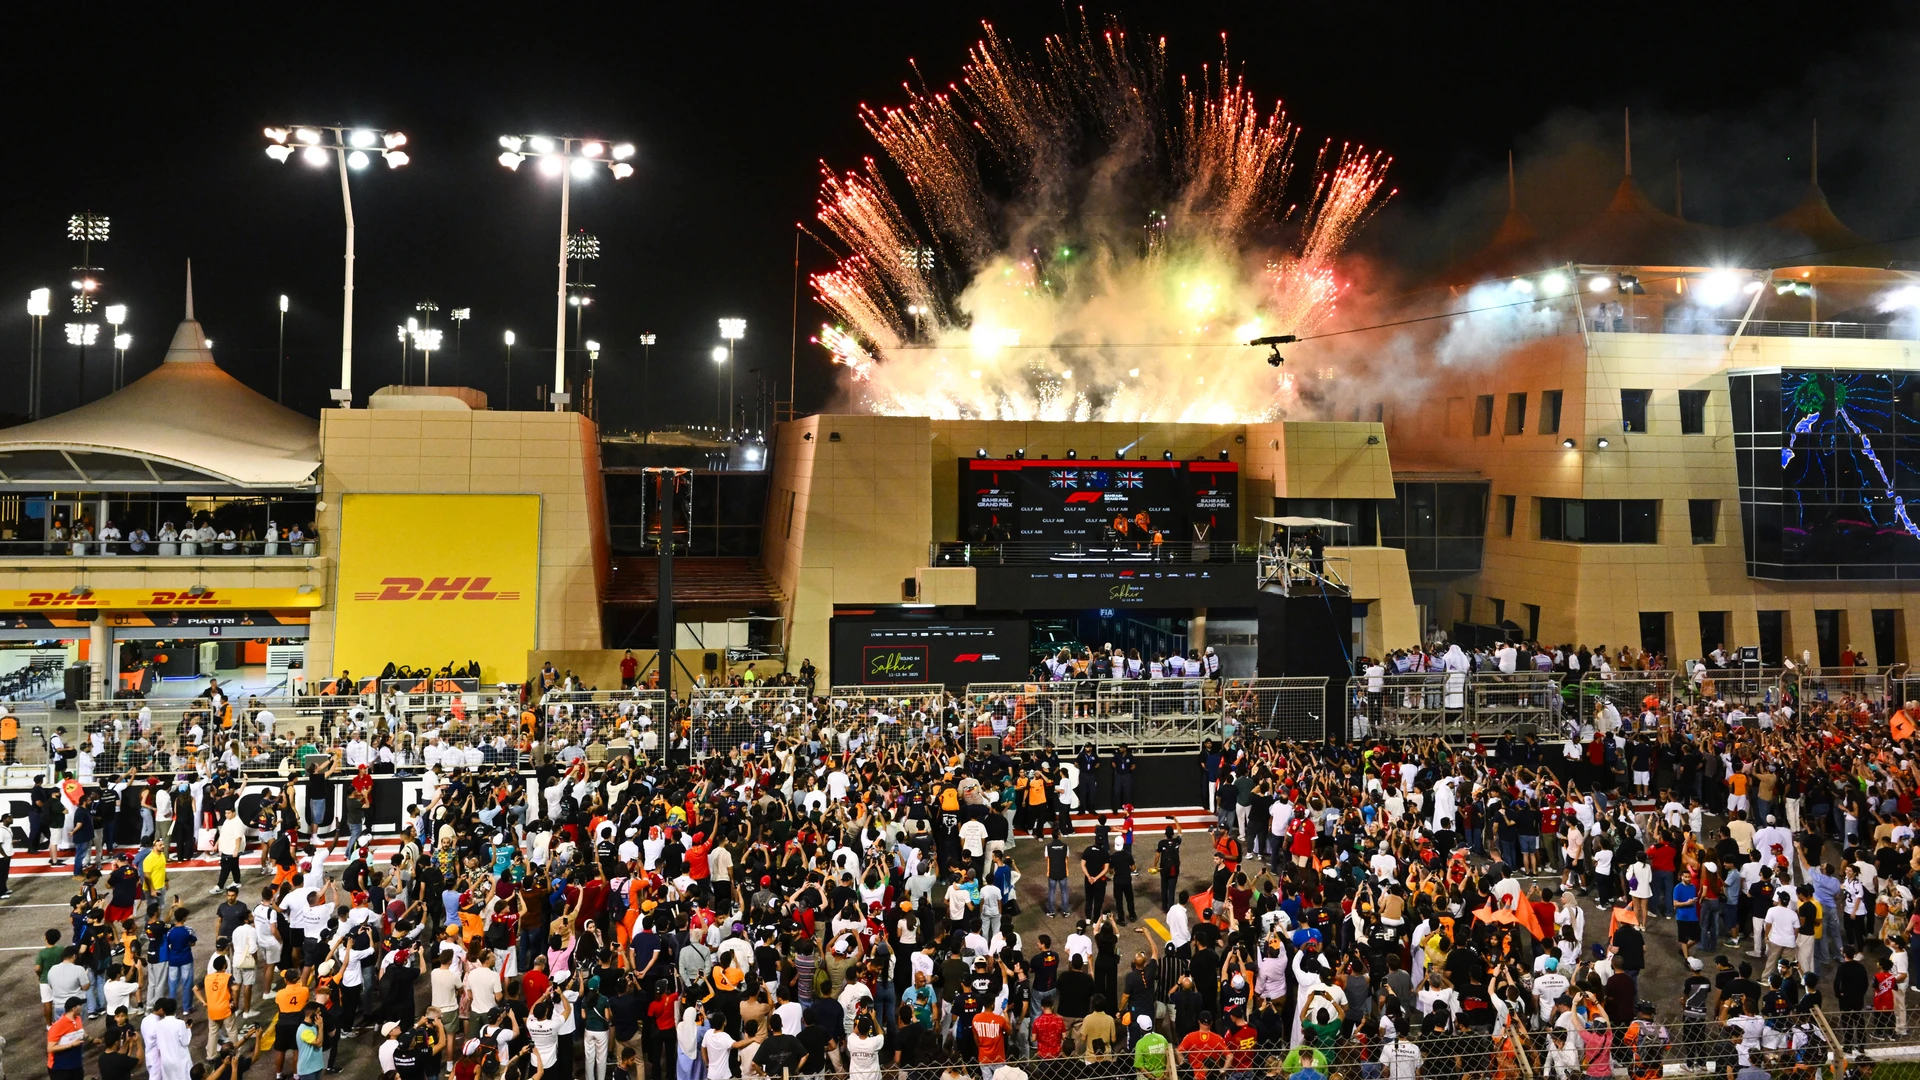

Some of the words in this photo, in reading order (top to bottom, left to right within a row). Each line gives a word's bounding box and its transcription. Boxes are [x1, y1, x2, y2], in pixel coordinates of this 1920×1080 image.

[377, 577, 498, 600] DHL
[1110, 584, 1139, 599] Sakhir
[27, 592, 97, 606] DHL
[151, 591, 221, 604] DHL
[871, 653, 914, 674] Sakhir
[434, 680, 454, 692] 81
[212, 982, 218, 991] 3
[289, 996, 298, 1005] 4
[1240, 1037, 1255, 1050] 55
